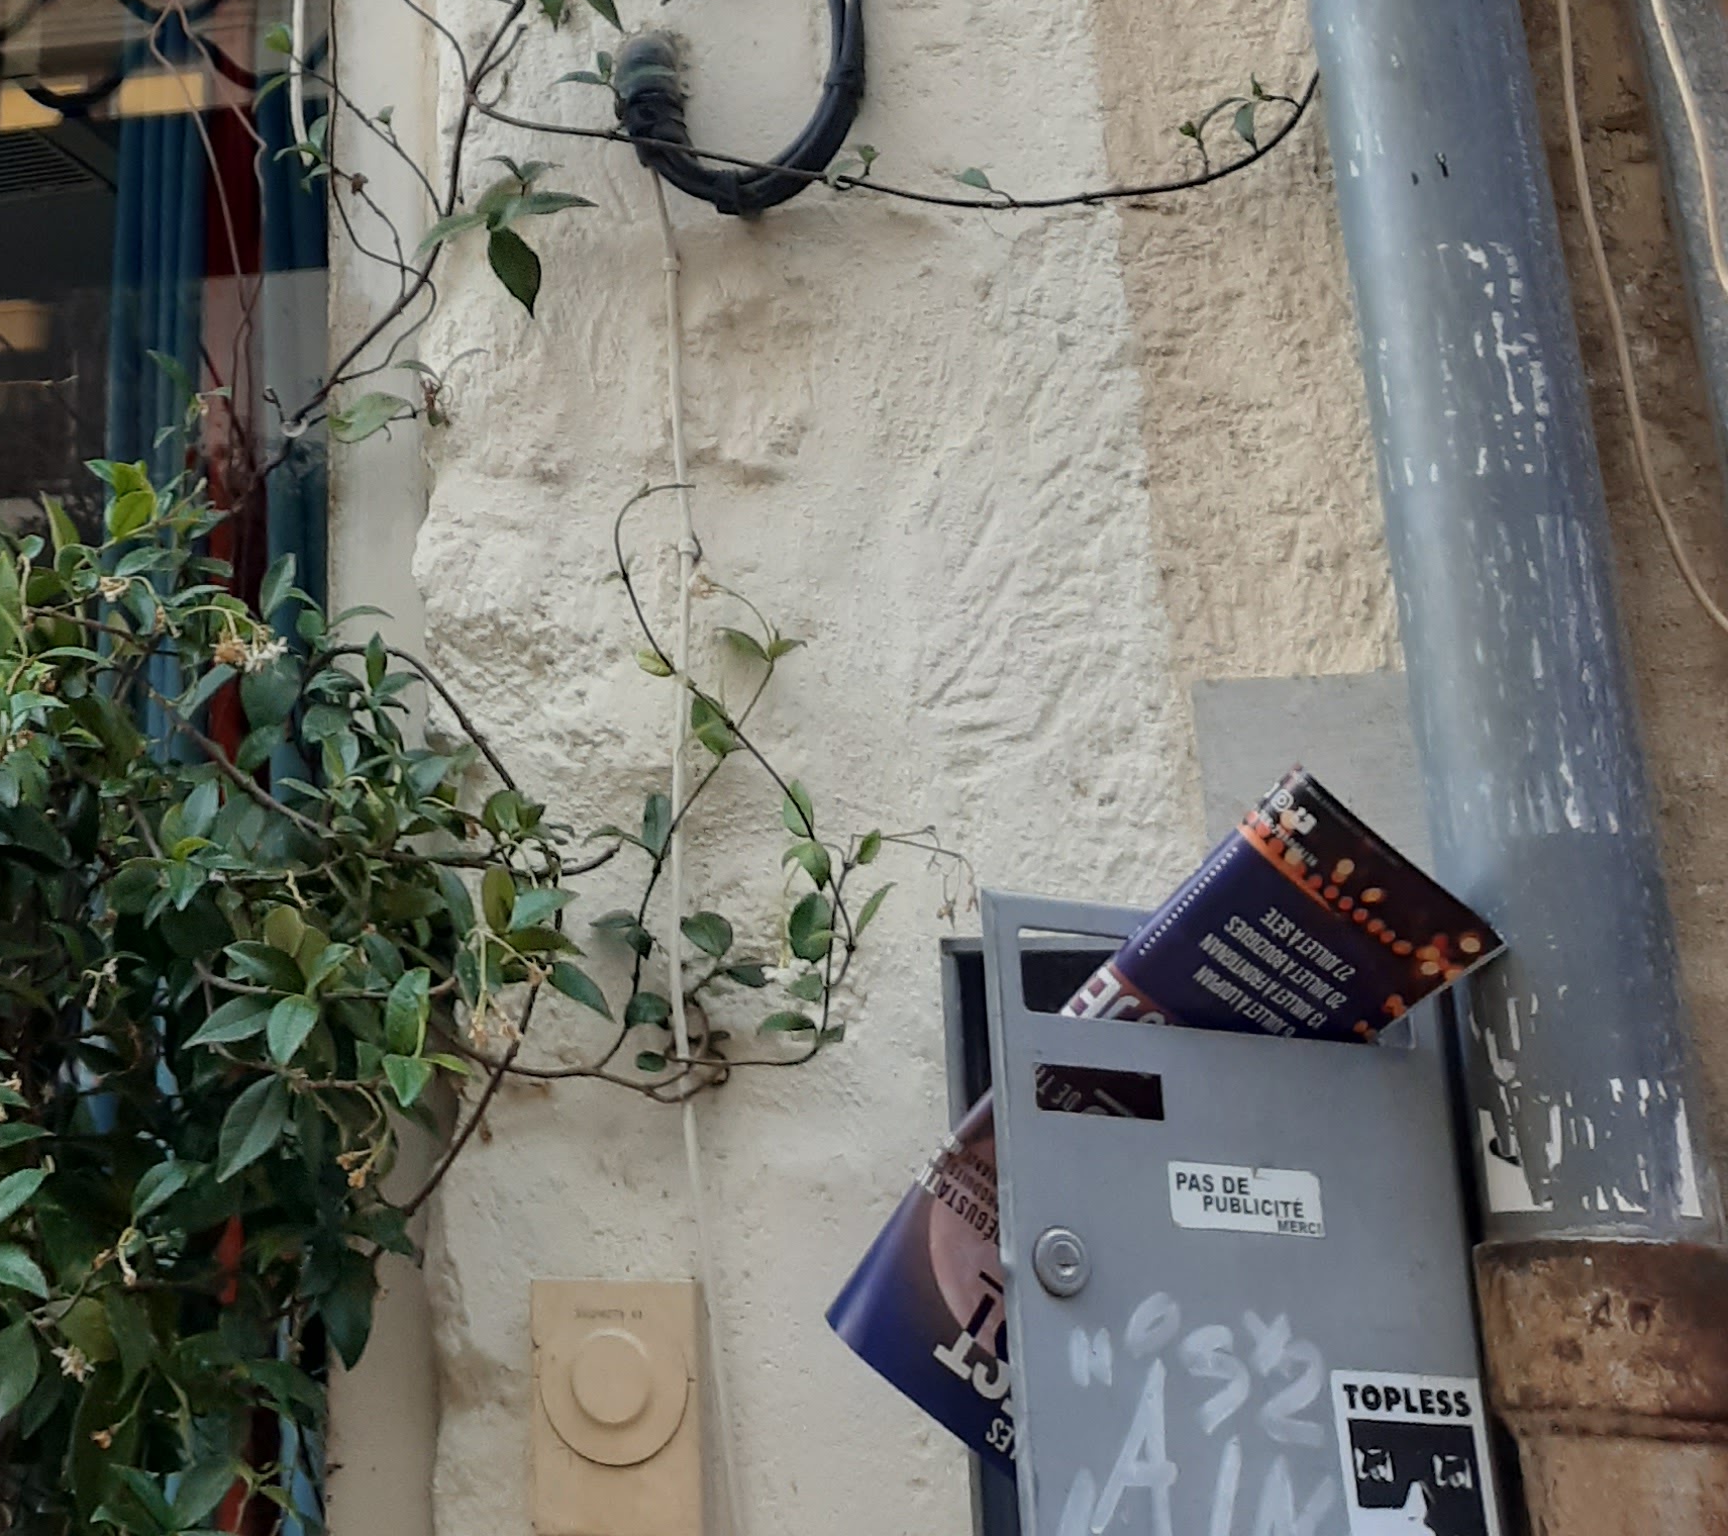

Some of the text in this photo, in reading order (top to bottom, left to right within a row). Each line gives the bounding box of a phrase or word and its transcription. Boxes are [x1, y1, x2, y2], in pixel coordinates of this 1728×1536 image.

[1223, 915, 1290, 970] BOUZIGUES
[1295, 936, 1343, 972] JUILLET
[1198, 932, 1268, 990] FRONTIGNAN
[1332, 964, 1356, 982] 27
[1192, 964, 1244, 1007] LOUPIAN
[1287, 966, 1330, 1001] JUILLET
[1242, 1001, 1288, 1035] JUILLET
[1270, 987, 1315, 1021] JUILLET
[1325, 992, 1348, 1010] 20
[1306, 1013, 1328, 1029] 13
[1175, 1171, 1251, 1196] PAS DE
[1203, 1194, 1305, 1219] PUBLICITÉ
[1277, 1220, 1322, 1235] MERCI
[1342, 1383, 1472, 1418] TOPLESS
